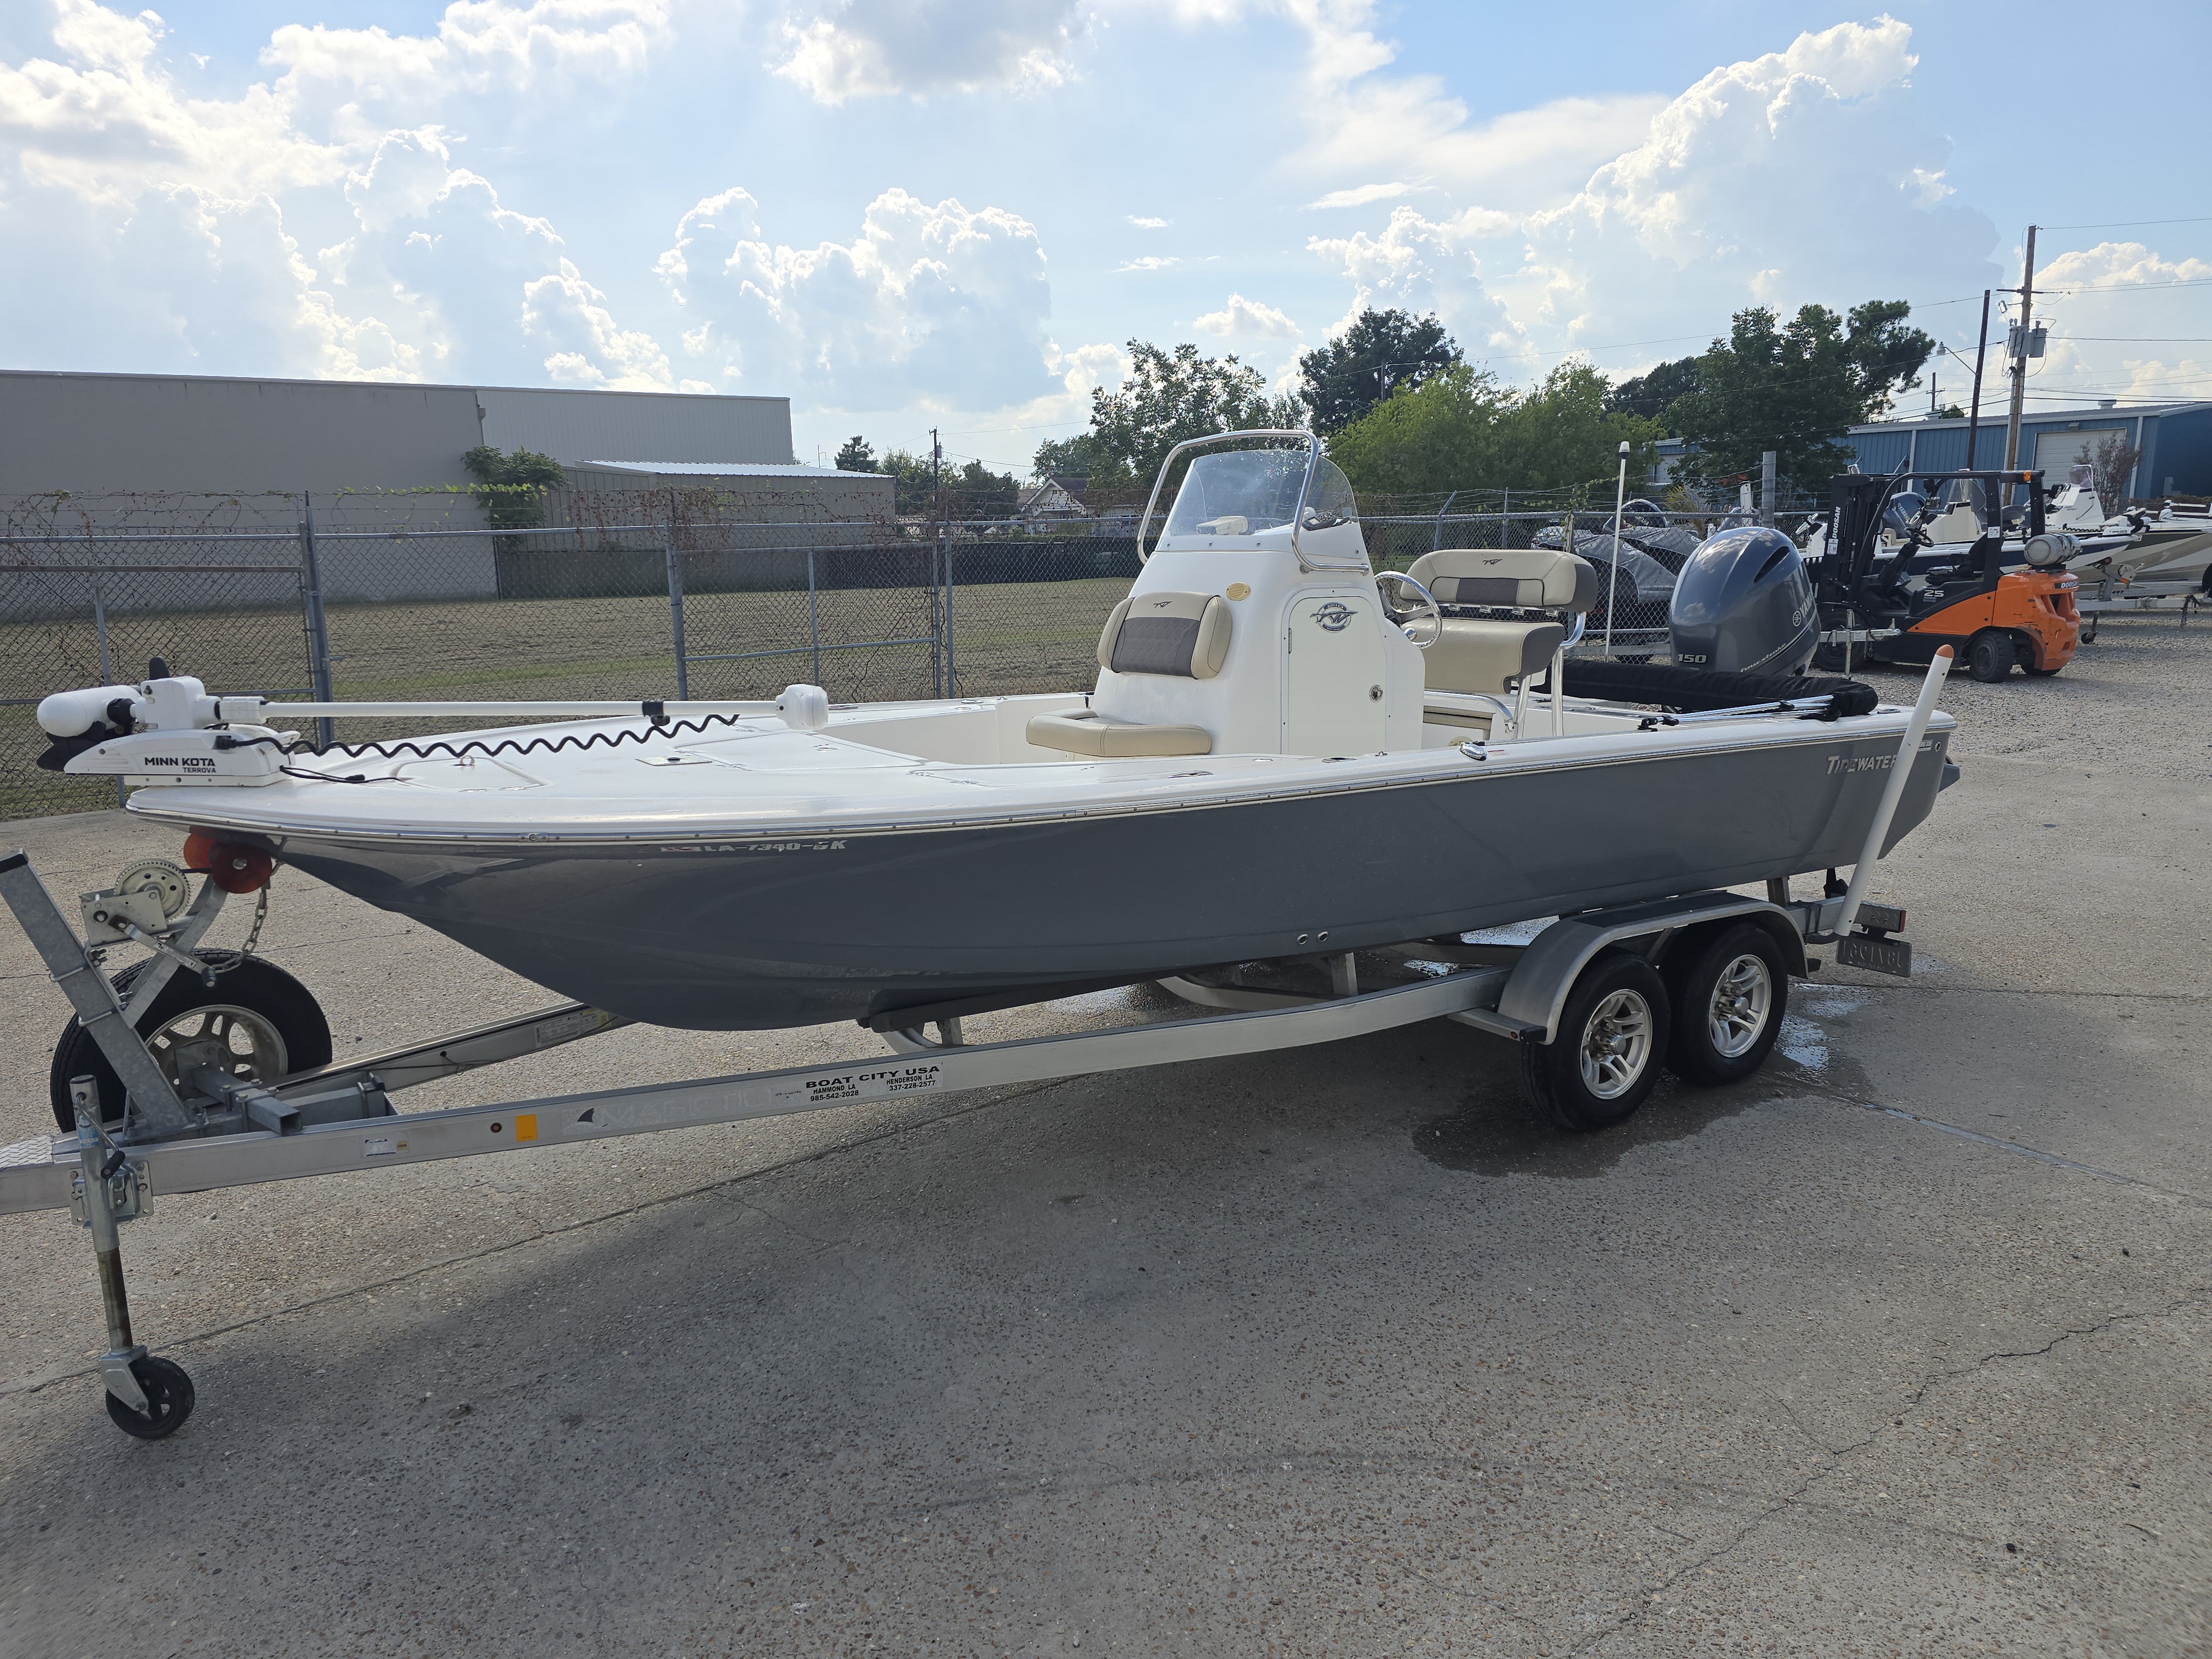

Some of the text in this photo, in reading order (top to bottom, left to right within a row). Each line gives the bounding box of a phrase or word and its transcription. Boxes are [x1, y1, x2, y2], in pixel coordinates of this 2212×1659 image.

[1832, 507, 1840, 539] DOOSAN
[1678, 654, 1707, 663] 150
[144, 757, 216, 766] MINN KOTA
[806, 1066, 940, 1088] BOAT CITY USA
[886, 1076, 922, 1085] HENDERSON
[889, 1080, 936, 1091] 337-228-2577
[810, 1090, 859, 1102] 985-542-2028
